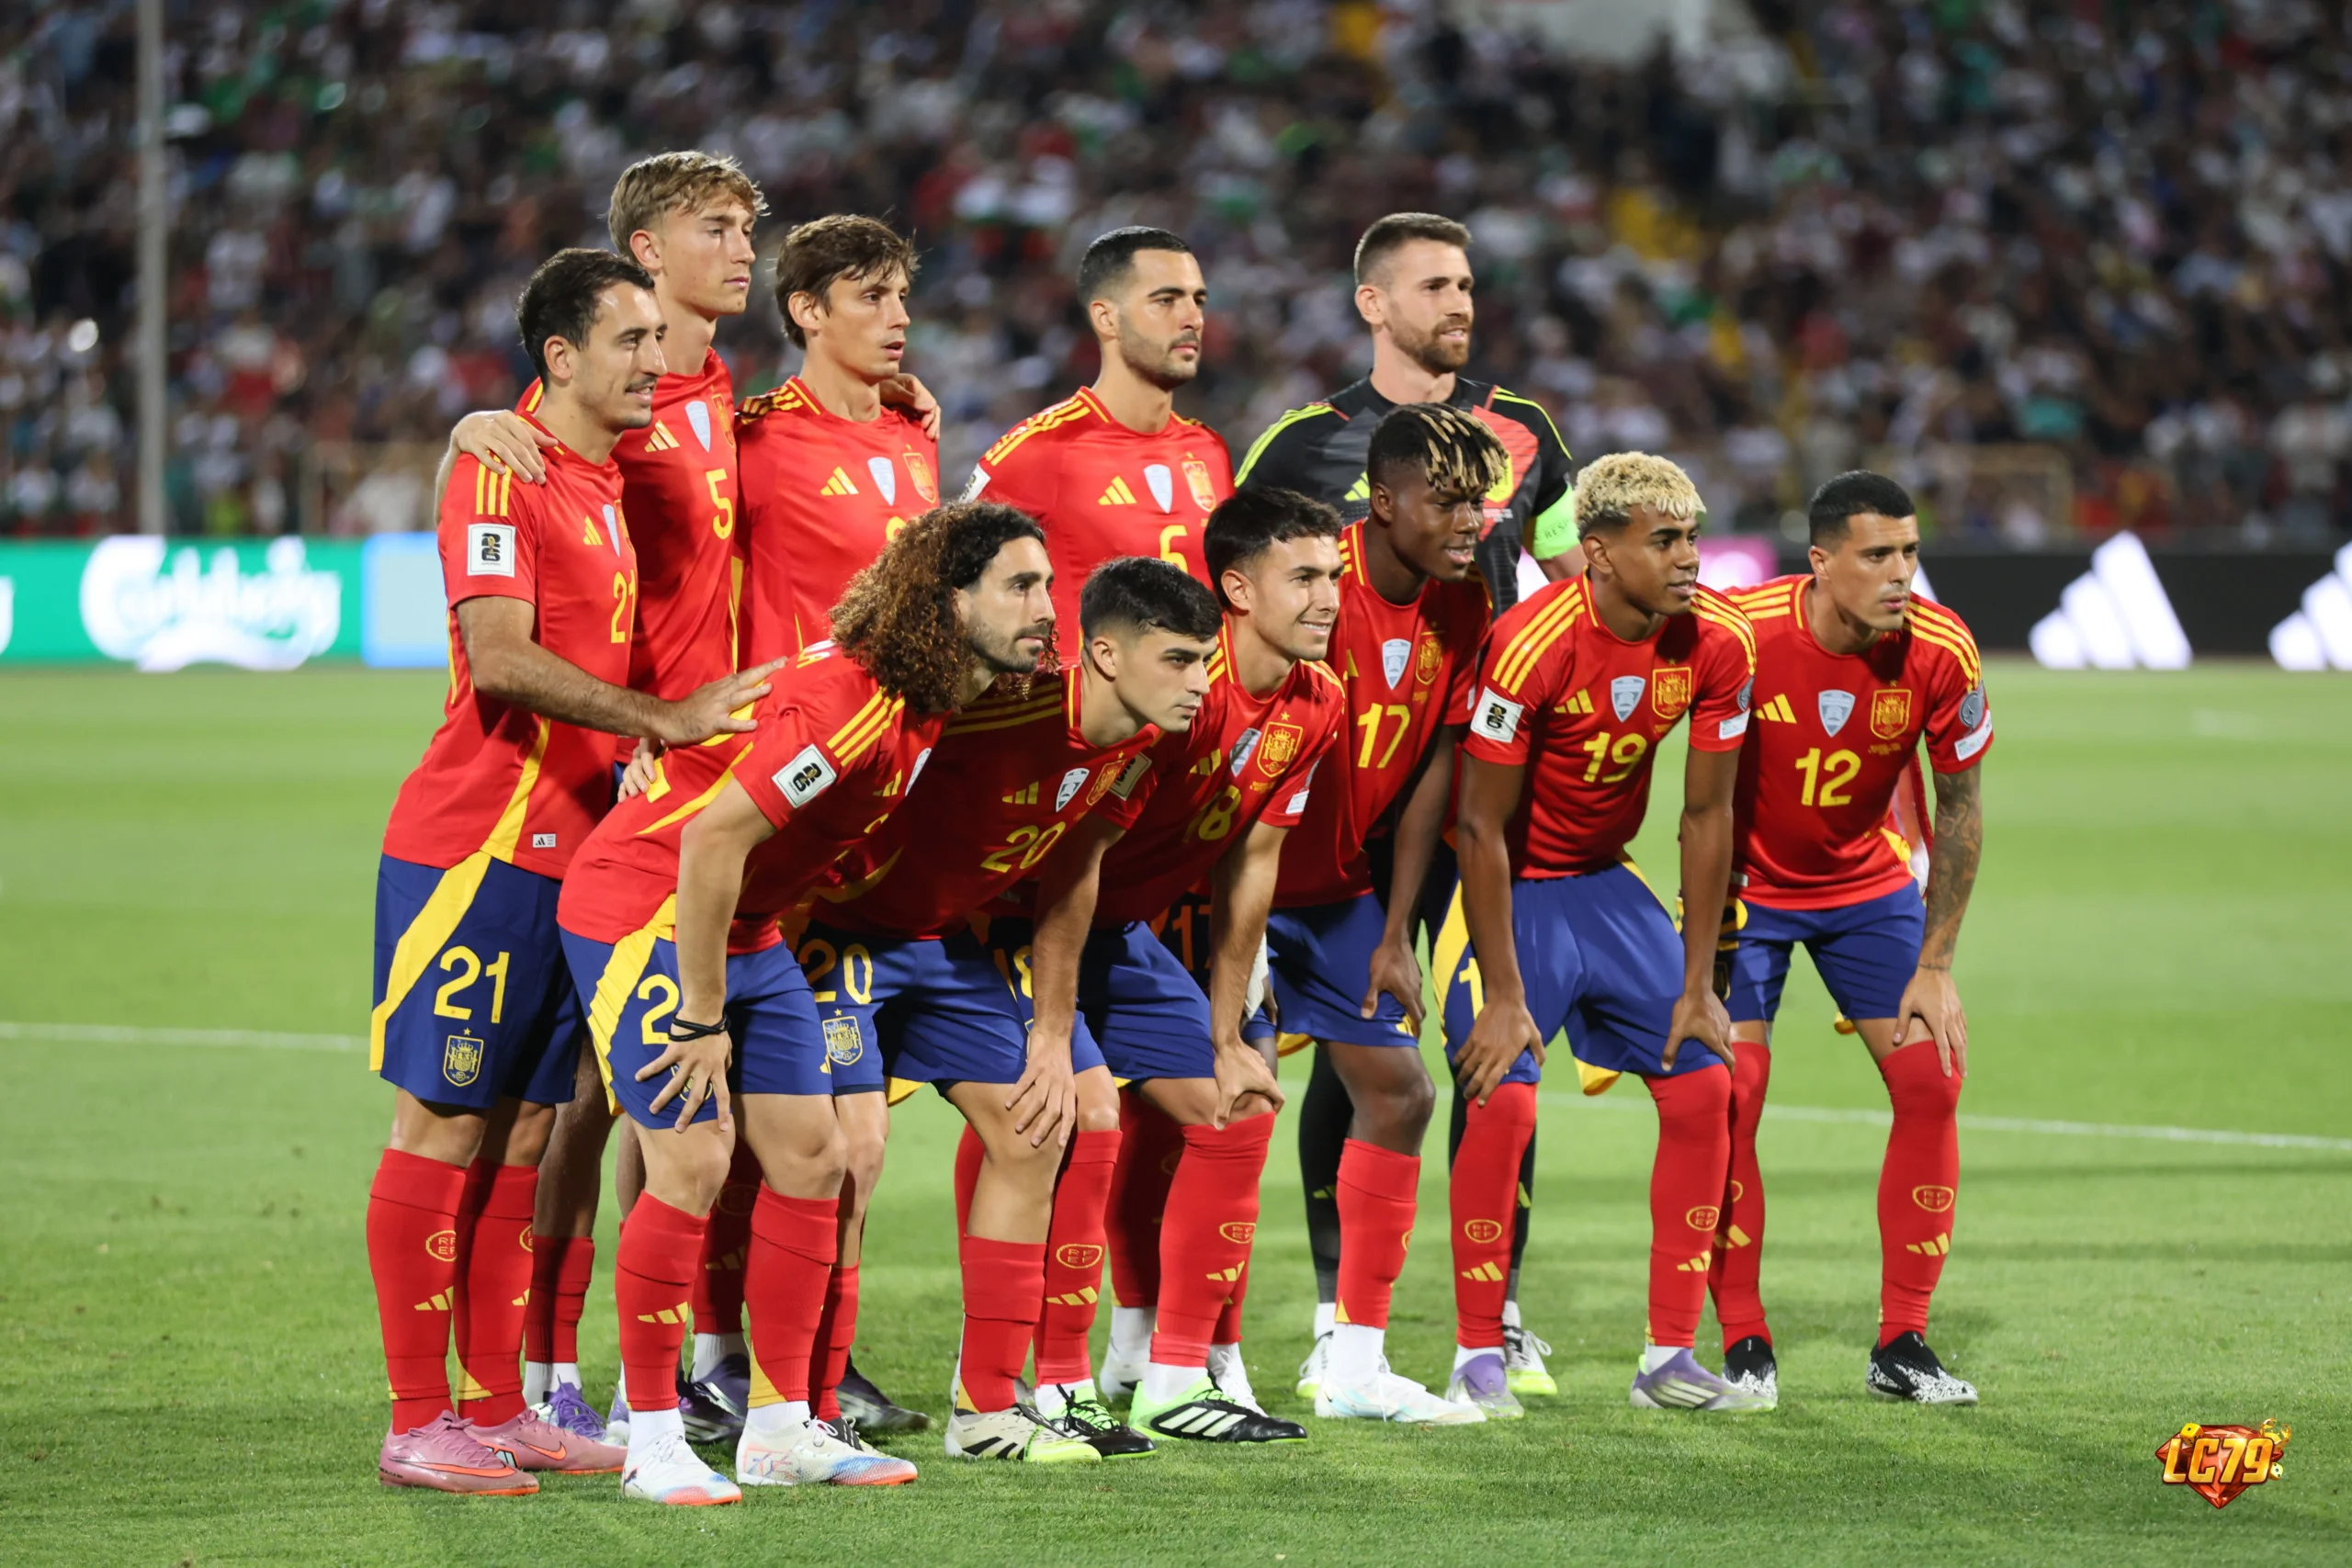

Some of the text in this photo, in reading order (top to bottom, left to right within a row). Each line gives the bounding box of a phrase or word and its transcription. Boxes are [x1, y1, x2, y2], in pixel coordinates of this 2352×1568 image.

[706, 468, 733, 540] 5
[79, 535, 341, 671] Carlsberg
[611, 569, 636, 643] 21
[1357, 702, 1411, 769] 17
[1583, 731, 1648, 784] 19
[1794, 747, 1862, 807] 12
[979, 821, 1067, 873] 20
[434, 945, 510, 1023] 21
[797, 938, 874, 1004] 20
[638, 974, 680, 1044] 2
